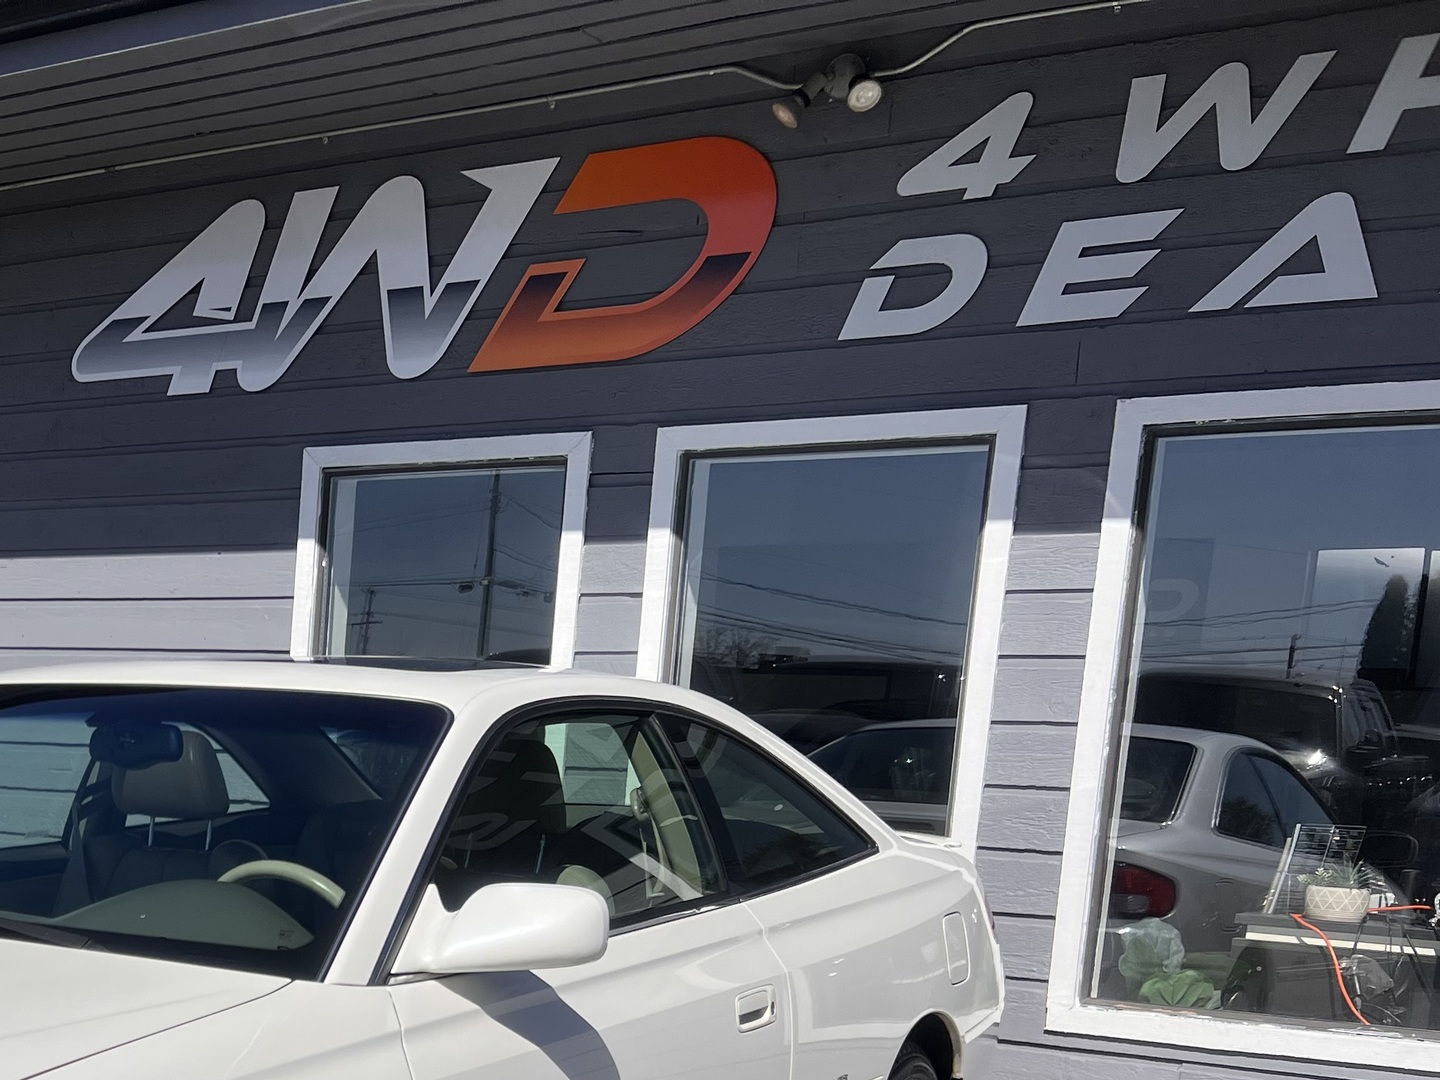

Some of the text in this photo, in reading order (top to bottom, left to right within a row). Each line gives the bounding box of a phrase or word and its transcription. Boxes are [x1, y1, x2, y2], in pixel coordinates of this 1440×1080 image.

[896, 91, 1038, 200] 4
[71, 135, 778, 396] 4WD
[837, 192, 1378, 340] DEA
